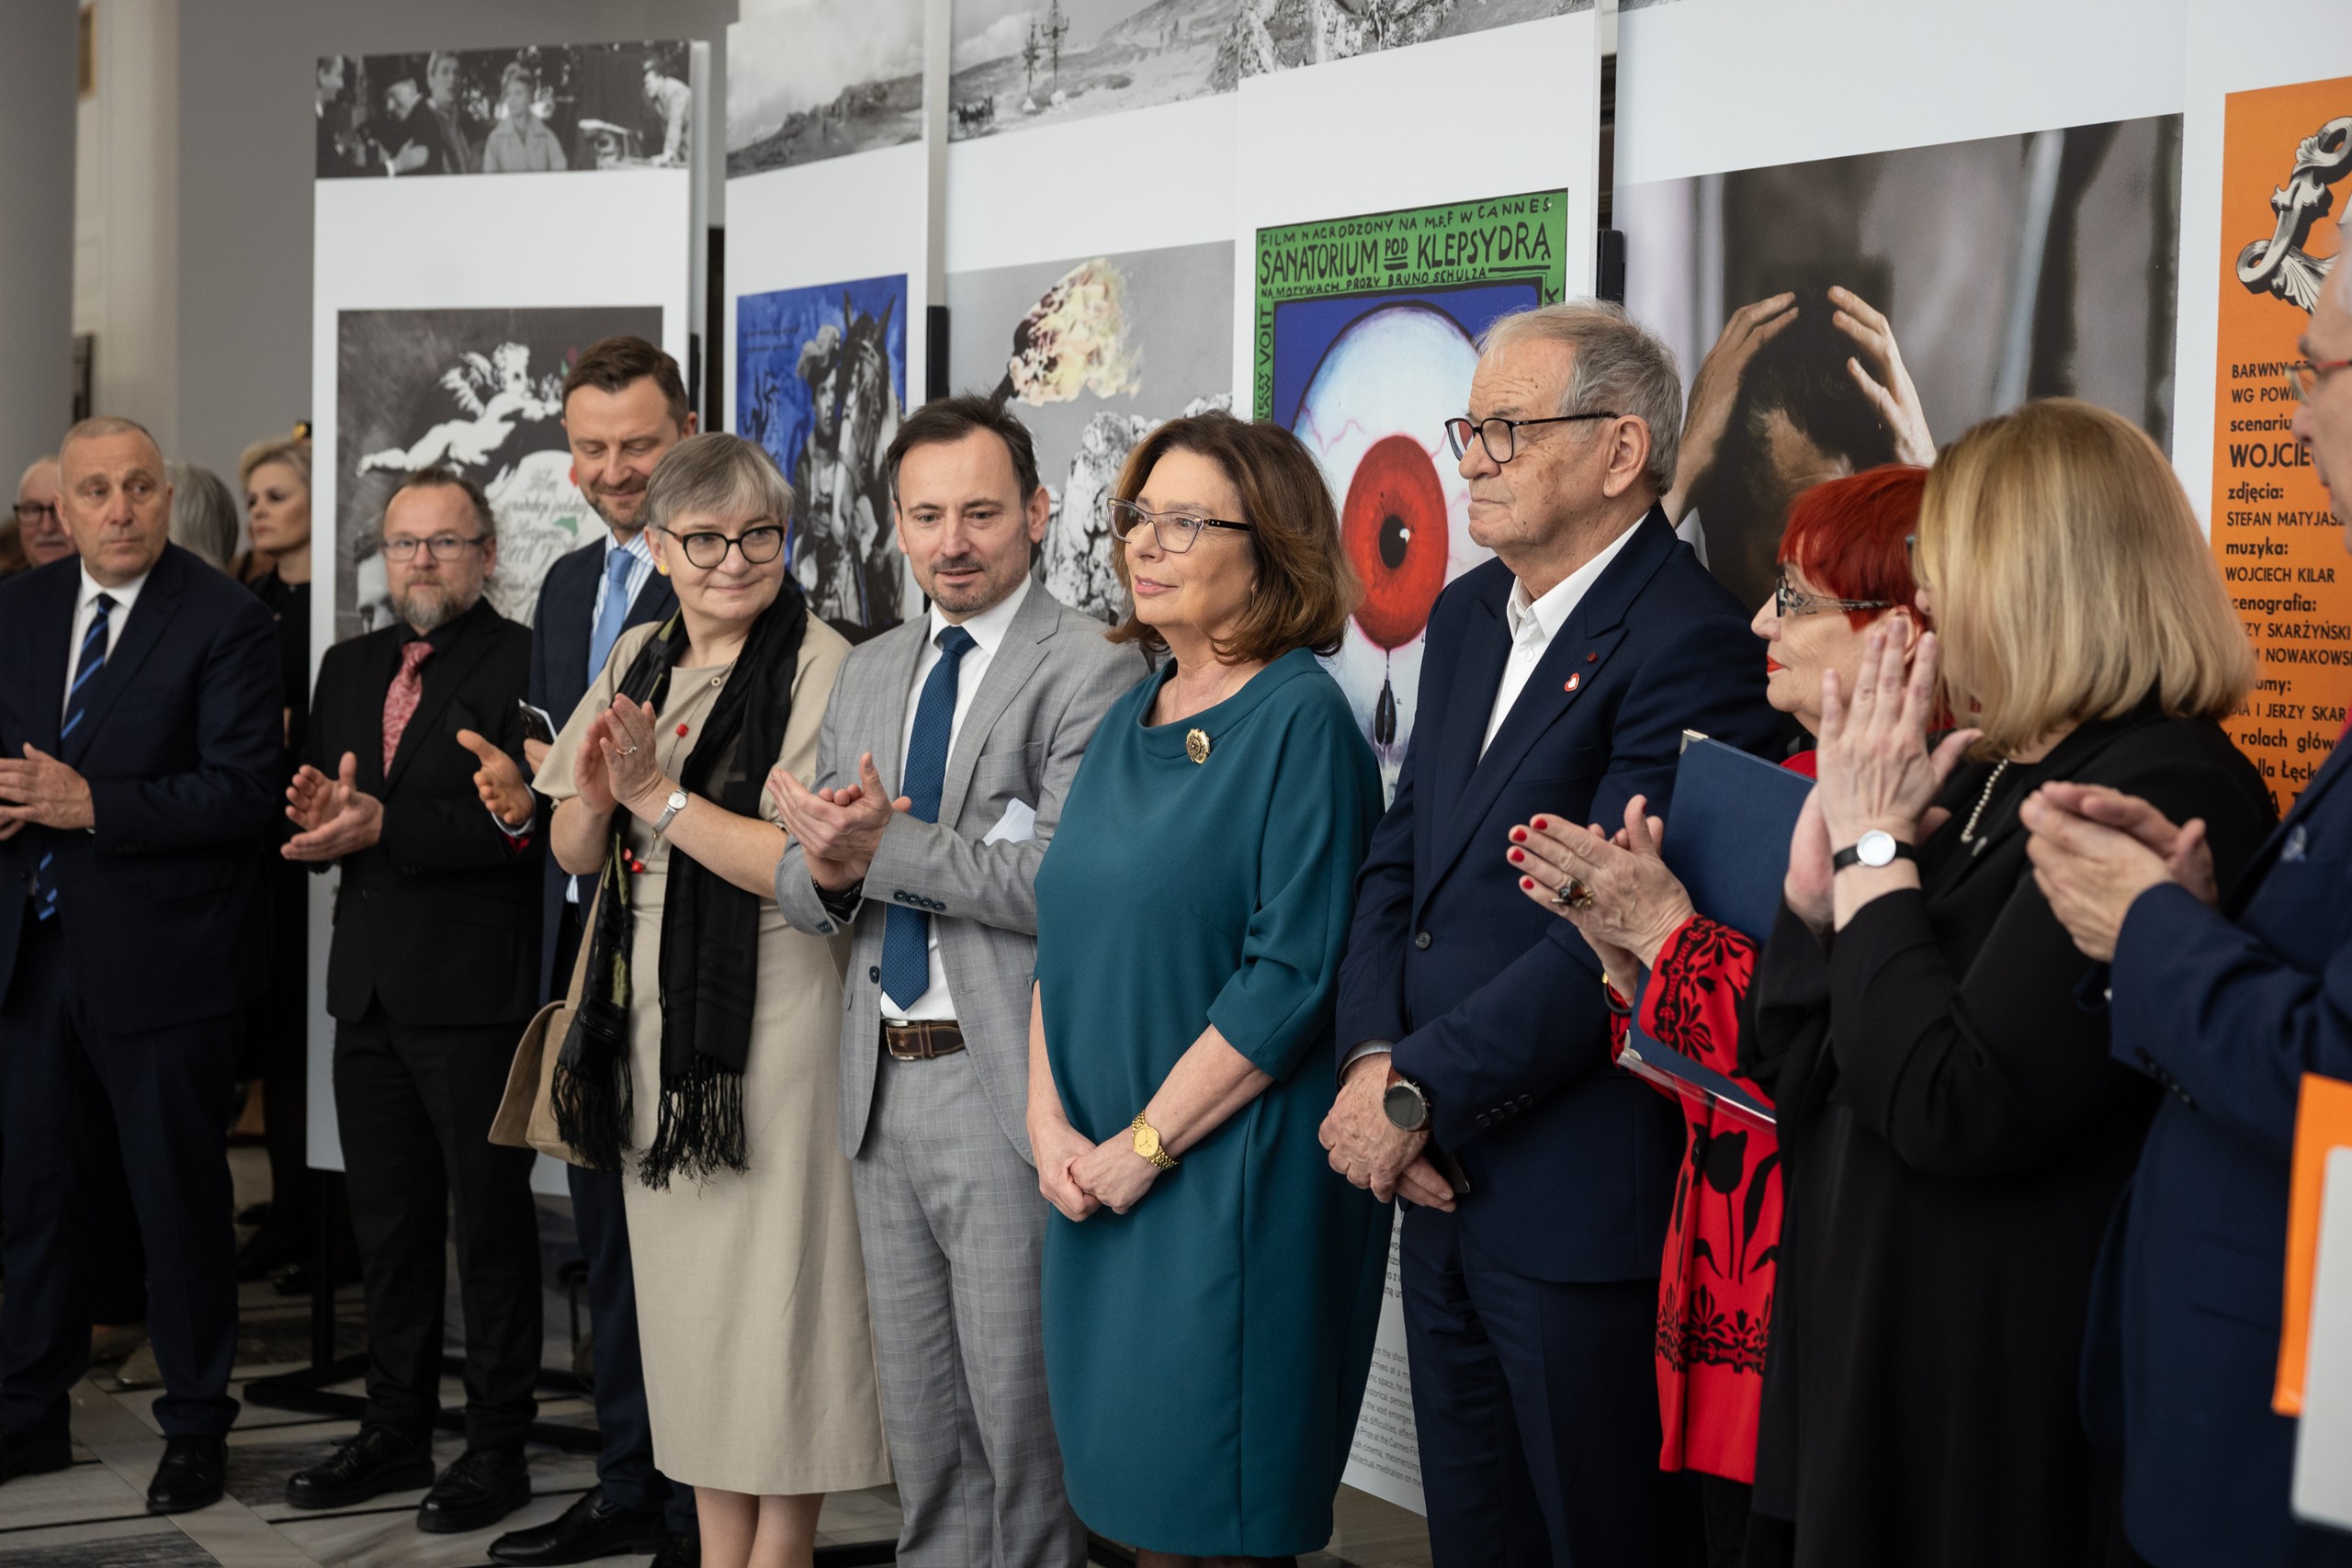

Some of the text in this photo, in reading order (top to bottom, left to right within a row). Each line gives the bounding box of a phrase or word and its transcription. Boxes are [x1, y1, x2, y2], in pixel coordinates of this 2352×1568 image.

[1261, 232, 1295, 246] FILM
[1302, 219, 1394, 241] NAGRODZONY
[1399, 218, 1417, 231] NA
[1461, 211, 1473, 223] W
[1477, 197, 1550, 219] CANNES
[1260, 221, 1551, 286] SANATORIUM POD KLEPSYDRĄ
[1261, 266, 1487, 299] NA MOTYWACH PROZY BRUNO SCHULZA
[1260, 303, 1272, 366] VOIT
[2232, 361, 2288, 378] BARWNY
[2232, 388, 2255, 403] WG
[2230, 413, 2293, 432] scenariu
[2229, 442, 2312, 468] WOJCIE
[2227, 480, 2284, 503] zdjęcia:
[2226, 511, 2272, 526] STEFAN
[2226, 536, 2289, 559] muzyka:
[2225, 567, 2335, 583] WOJCIECH KILAR
[2233, 592, 2317, 615] cenografia:
[2267, 619, 2351, 640] SKARŻYŃSKI
[2266, 648, 2352, 666] NOWAKOWS
[2266, 704, 2306, 719] JERZY
[2312, 705, 2347, 722] SKAR
[2241, 727, 2335, 753] rolach głów
[2281, 759, 2316, 783] Łęck
